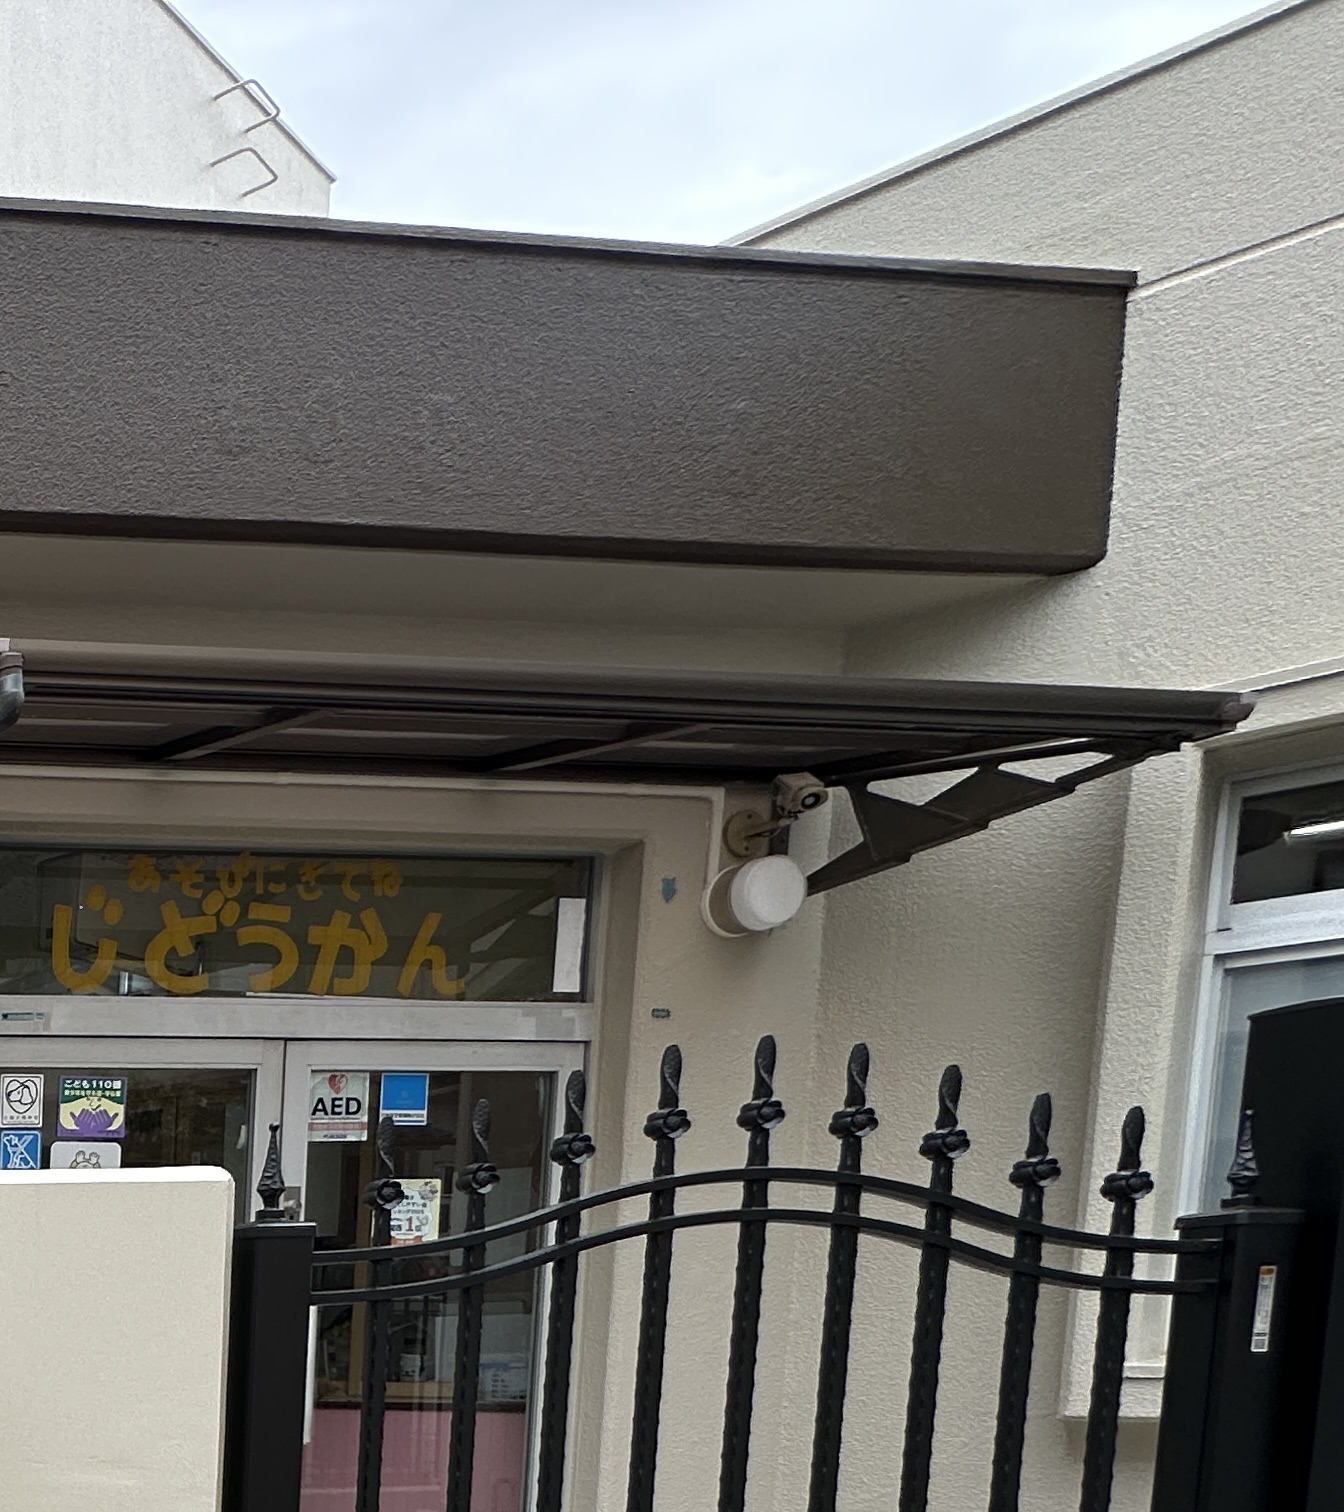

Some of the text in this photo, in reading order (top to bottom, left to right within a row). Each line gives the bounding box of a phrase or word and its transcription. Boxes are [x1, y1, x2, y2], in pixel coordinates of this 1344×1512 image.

[127, 850, 403, 901] あそびにきてね
[52, 884, 466, 996] じどうかん
[312, 1097, 361, 1116] AED
